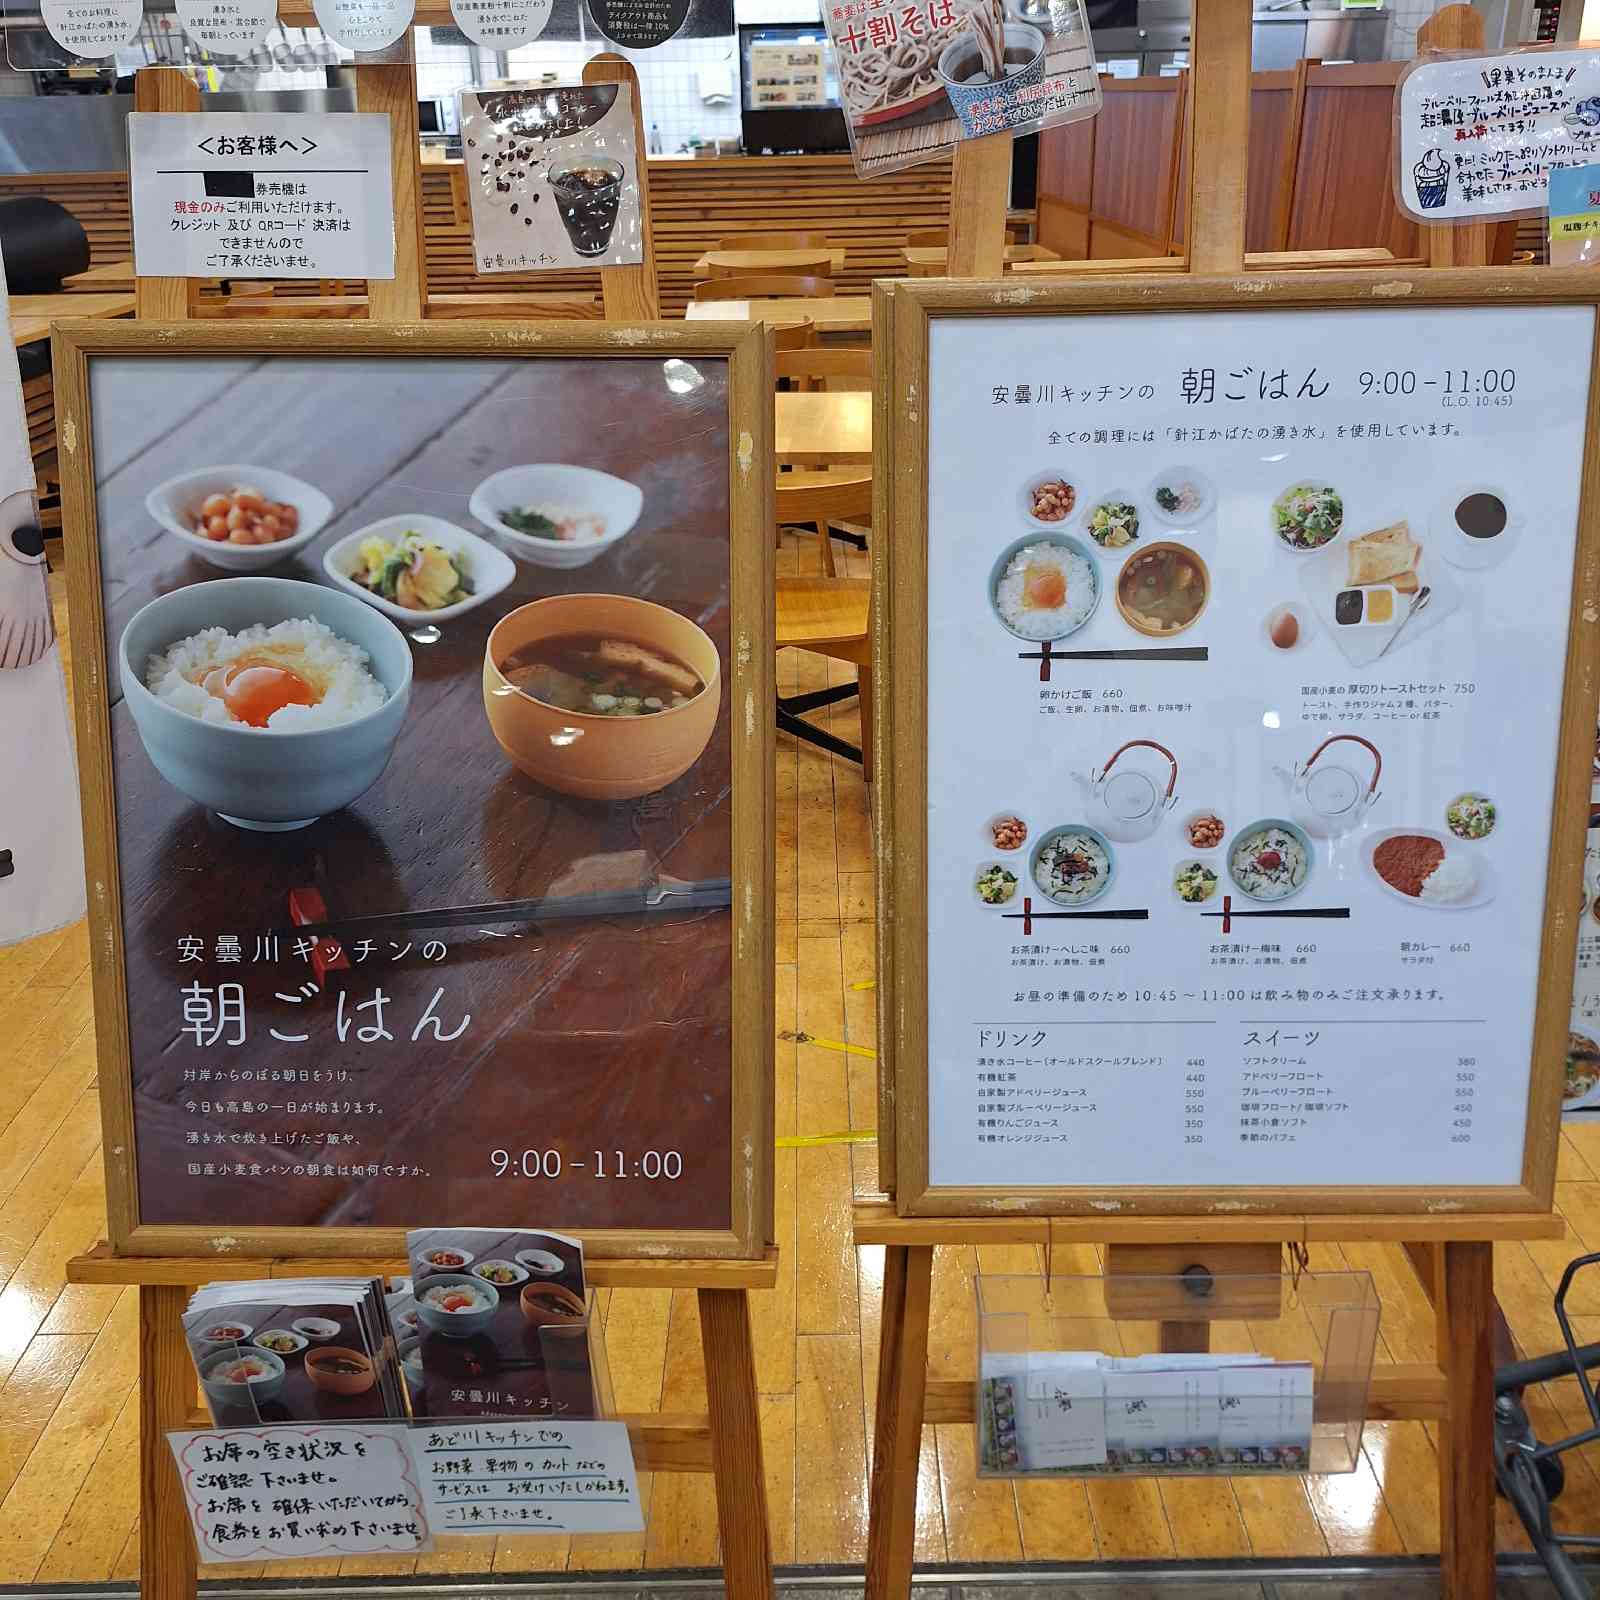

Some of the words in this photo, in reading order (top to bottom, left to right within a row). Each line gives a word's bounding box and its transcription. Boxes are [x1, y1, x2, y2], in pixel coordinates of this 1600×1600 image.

[174, 202, 343, 215] 現金のみご利用いただけます。
[219, 238, 304, 249] できませんので
[991, 383, 1155, 406] 安曇川キッチンの
[1181, 366, 1331, 405] 朝ごはん
[1039, 688, 1093, 700] 卵かけご飯
[1102, 688, 1124, 699] 660
[1454, 683, 1475, 694] 750
[176, 934, 448, 963] 安曇川キッチンの
[1110, 944, 1131, 954] 660
[1296, 943, 1318, 953] 660
[1450, 942, 1472, 952] 660
[179, 979, 472, 1047] 朝ごはん
[978, 1029, 1048, 1048] ドリンク
[1243, 1029, 1321, 1047] スイーツ
[184, 1100, 386, 1115] 今日も高島の一日が始まります。
[187, 1162, 432, 1177] 国産小麦食パンの朝食は如何ですか。
[450, 1388, 569, 1412] 安曇川キッチン
